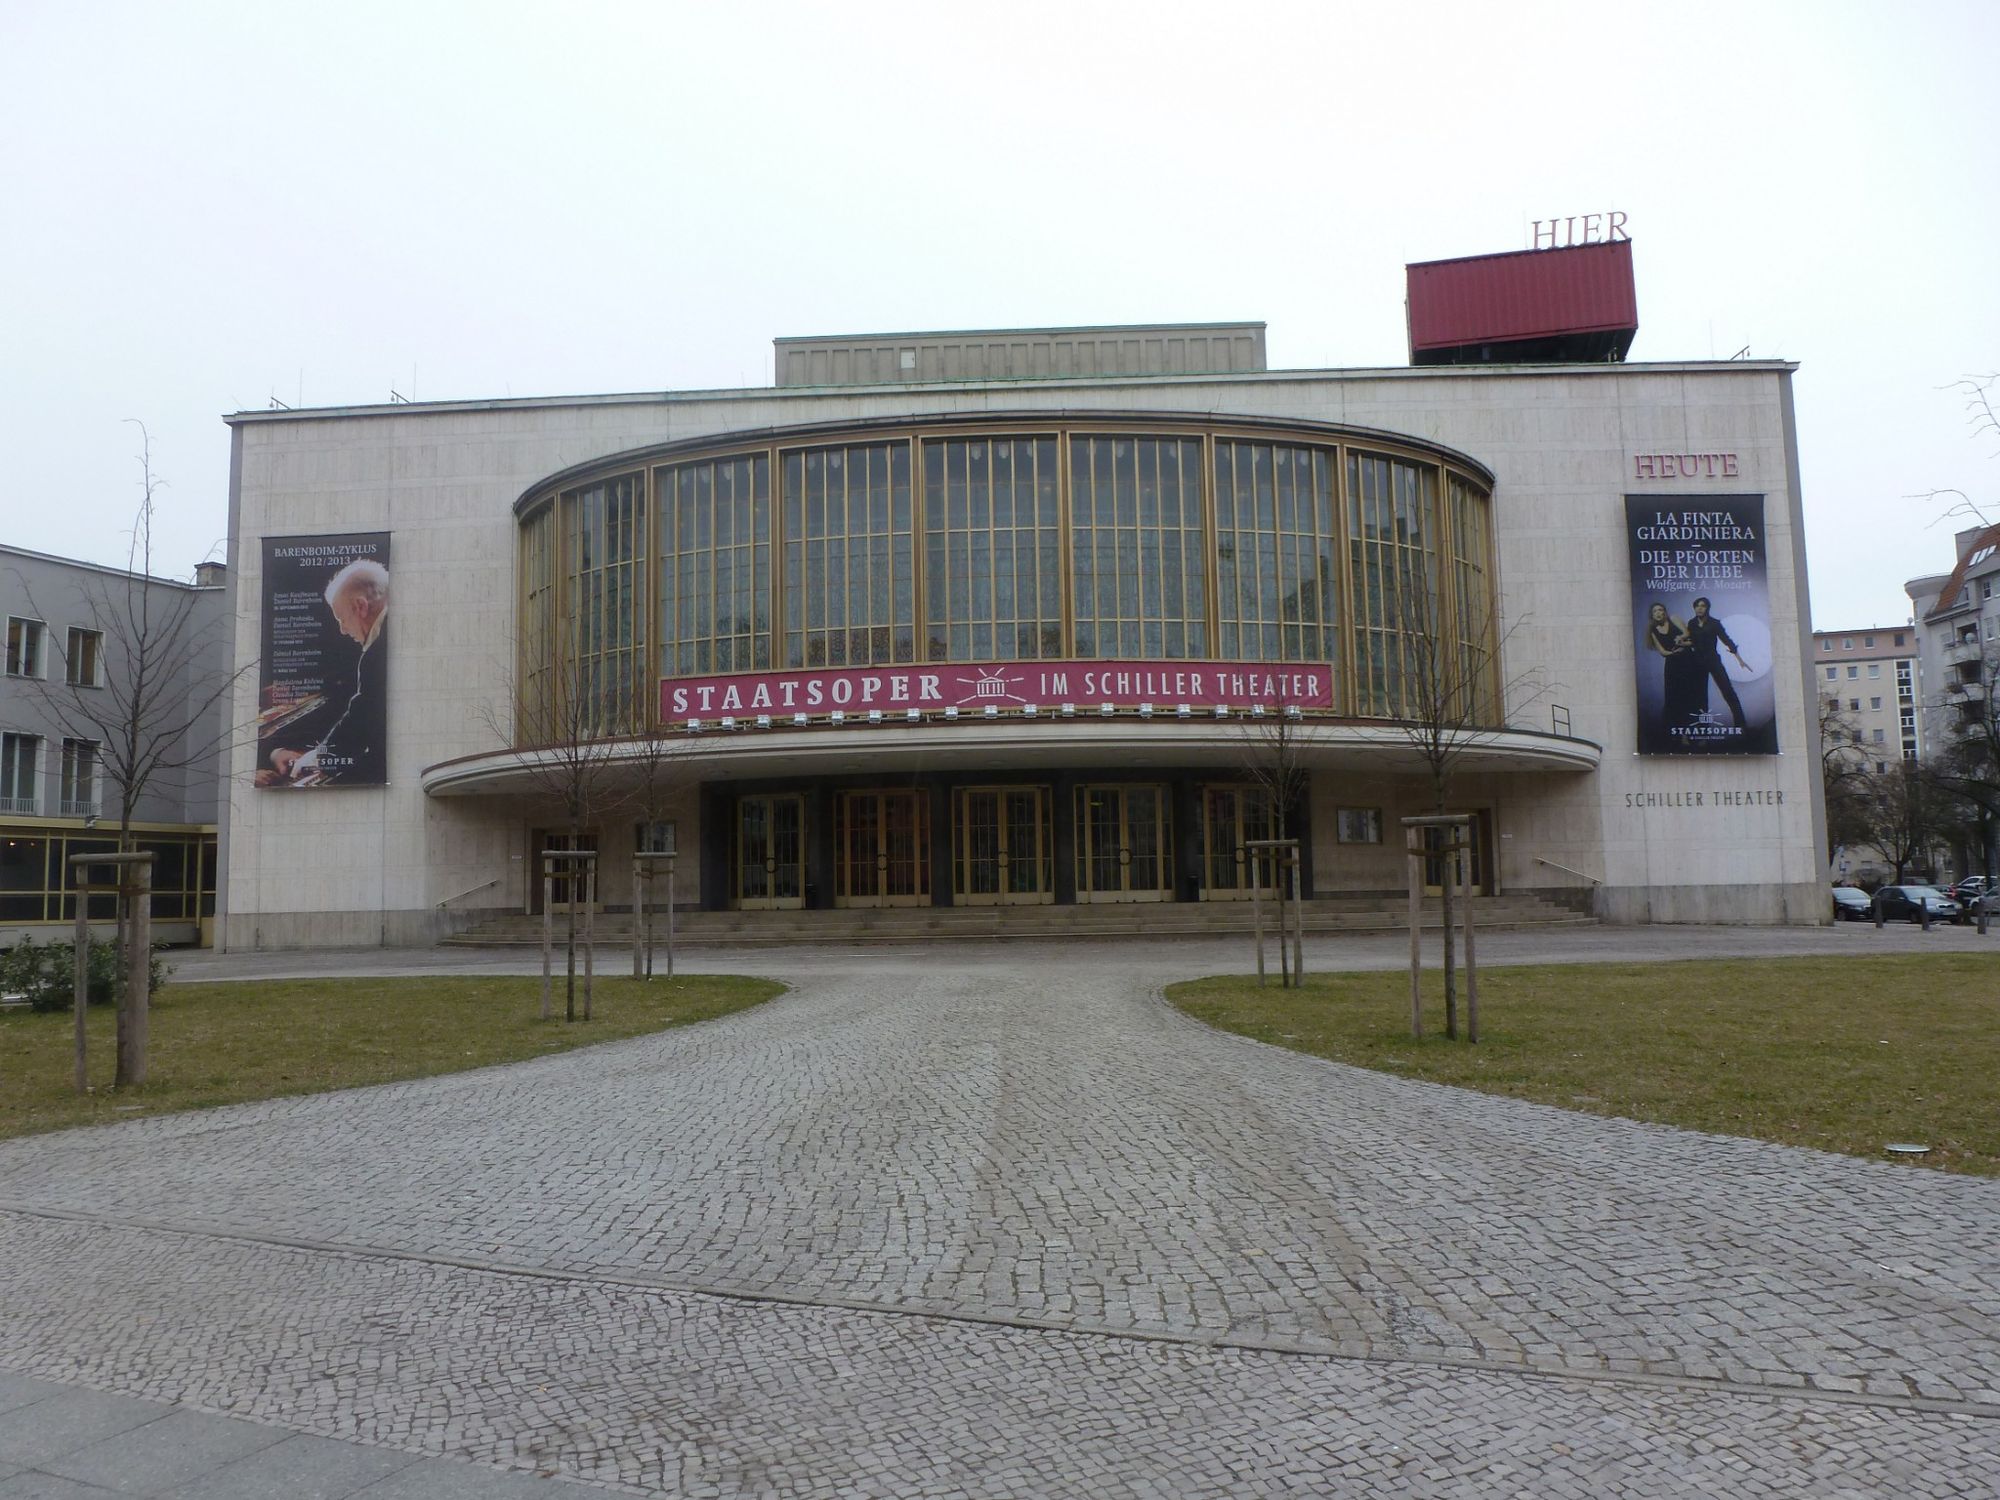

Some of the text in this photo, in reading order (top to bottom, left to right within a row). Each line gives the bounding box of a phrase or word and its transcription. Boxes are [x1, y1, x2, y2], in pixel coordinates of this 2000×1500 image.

[1531, 211, 1630, 251] HIER
[1634, 454, 1739, 478] HEUTE
[1656, 512, 1734, 525] LA FINTA
[1637, 527, 1755, 540] GIARDINIERA
[274, 544, 376, 557] BARENBOIM-ZYKLUS
[1640, 551, 1754, 564] DIE PFORTEN
[1653, 565, 1743, 578] DER LIEBE
[1646, 580, 1696, 592] Wolfgang
[1714, 580, 1752, 589] Mozart
[673, 672, 1320, 713] STAATSOPER IM SCHILLER THEATER
[1671, 727, 1742, 735] STAATSOPER
[1625, 790, 1784, 807] SCHILLER THEATER
